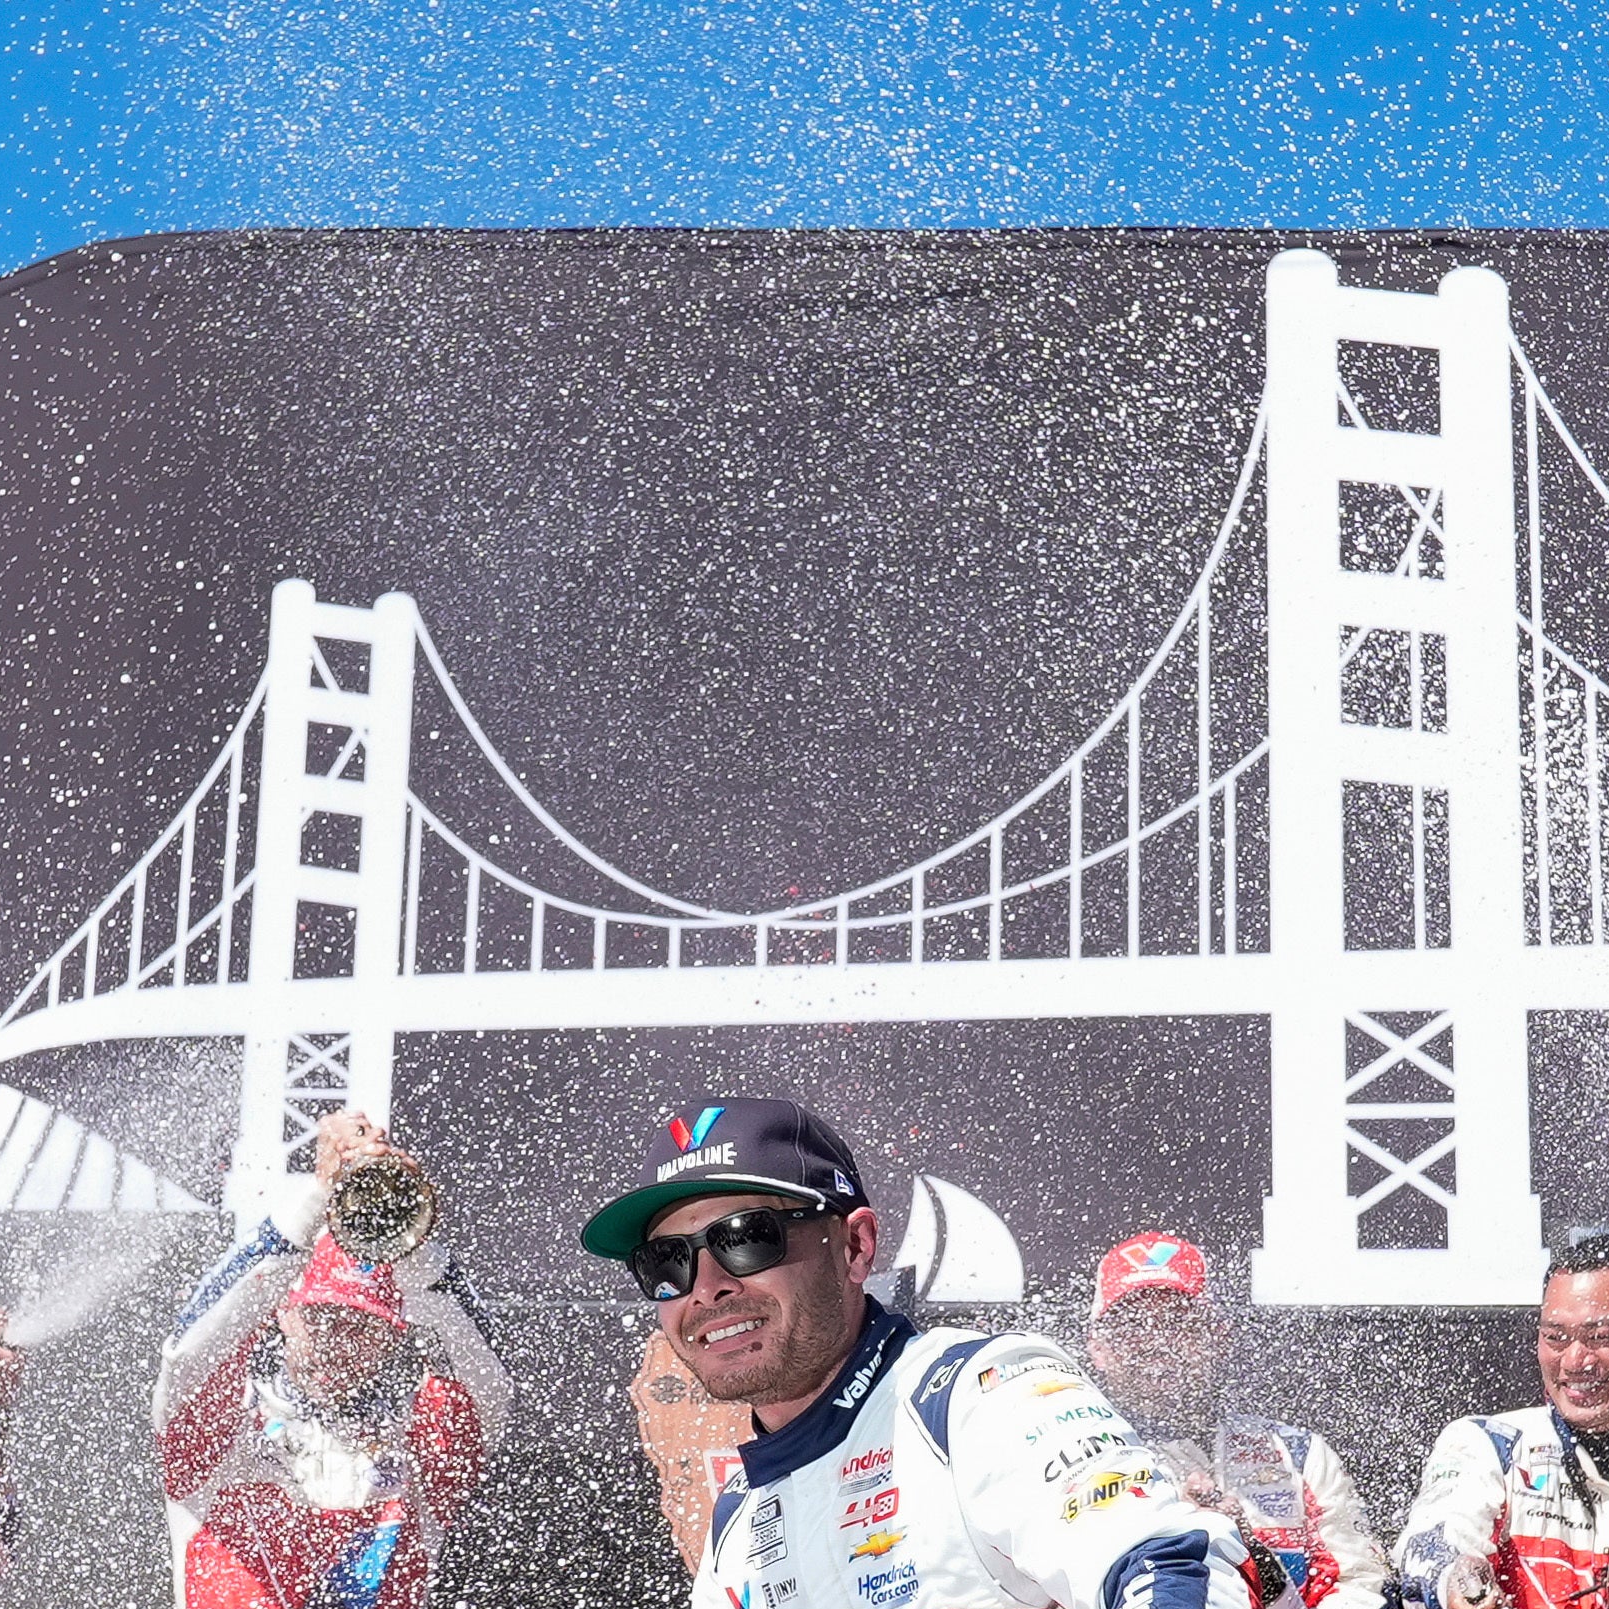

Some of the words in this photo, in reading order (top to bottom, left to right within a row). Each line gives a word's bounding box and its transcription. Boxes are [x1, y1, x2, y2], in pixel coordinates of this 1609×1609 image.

[657, 1142, 738, 1182] VALVOLINE
[1026, 1407, 1114, 1446] SIMENS
[858, 1559, 917, 1600] Hendrick
[871, 1577, 920, 1606] Cars.com
